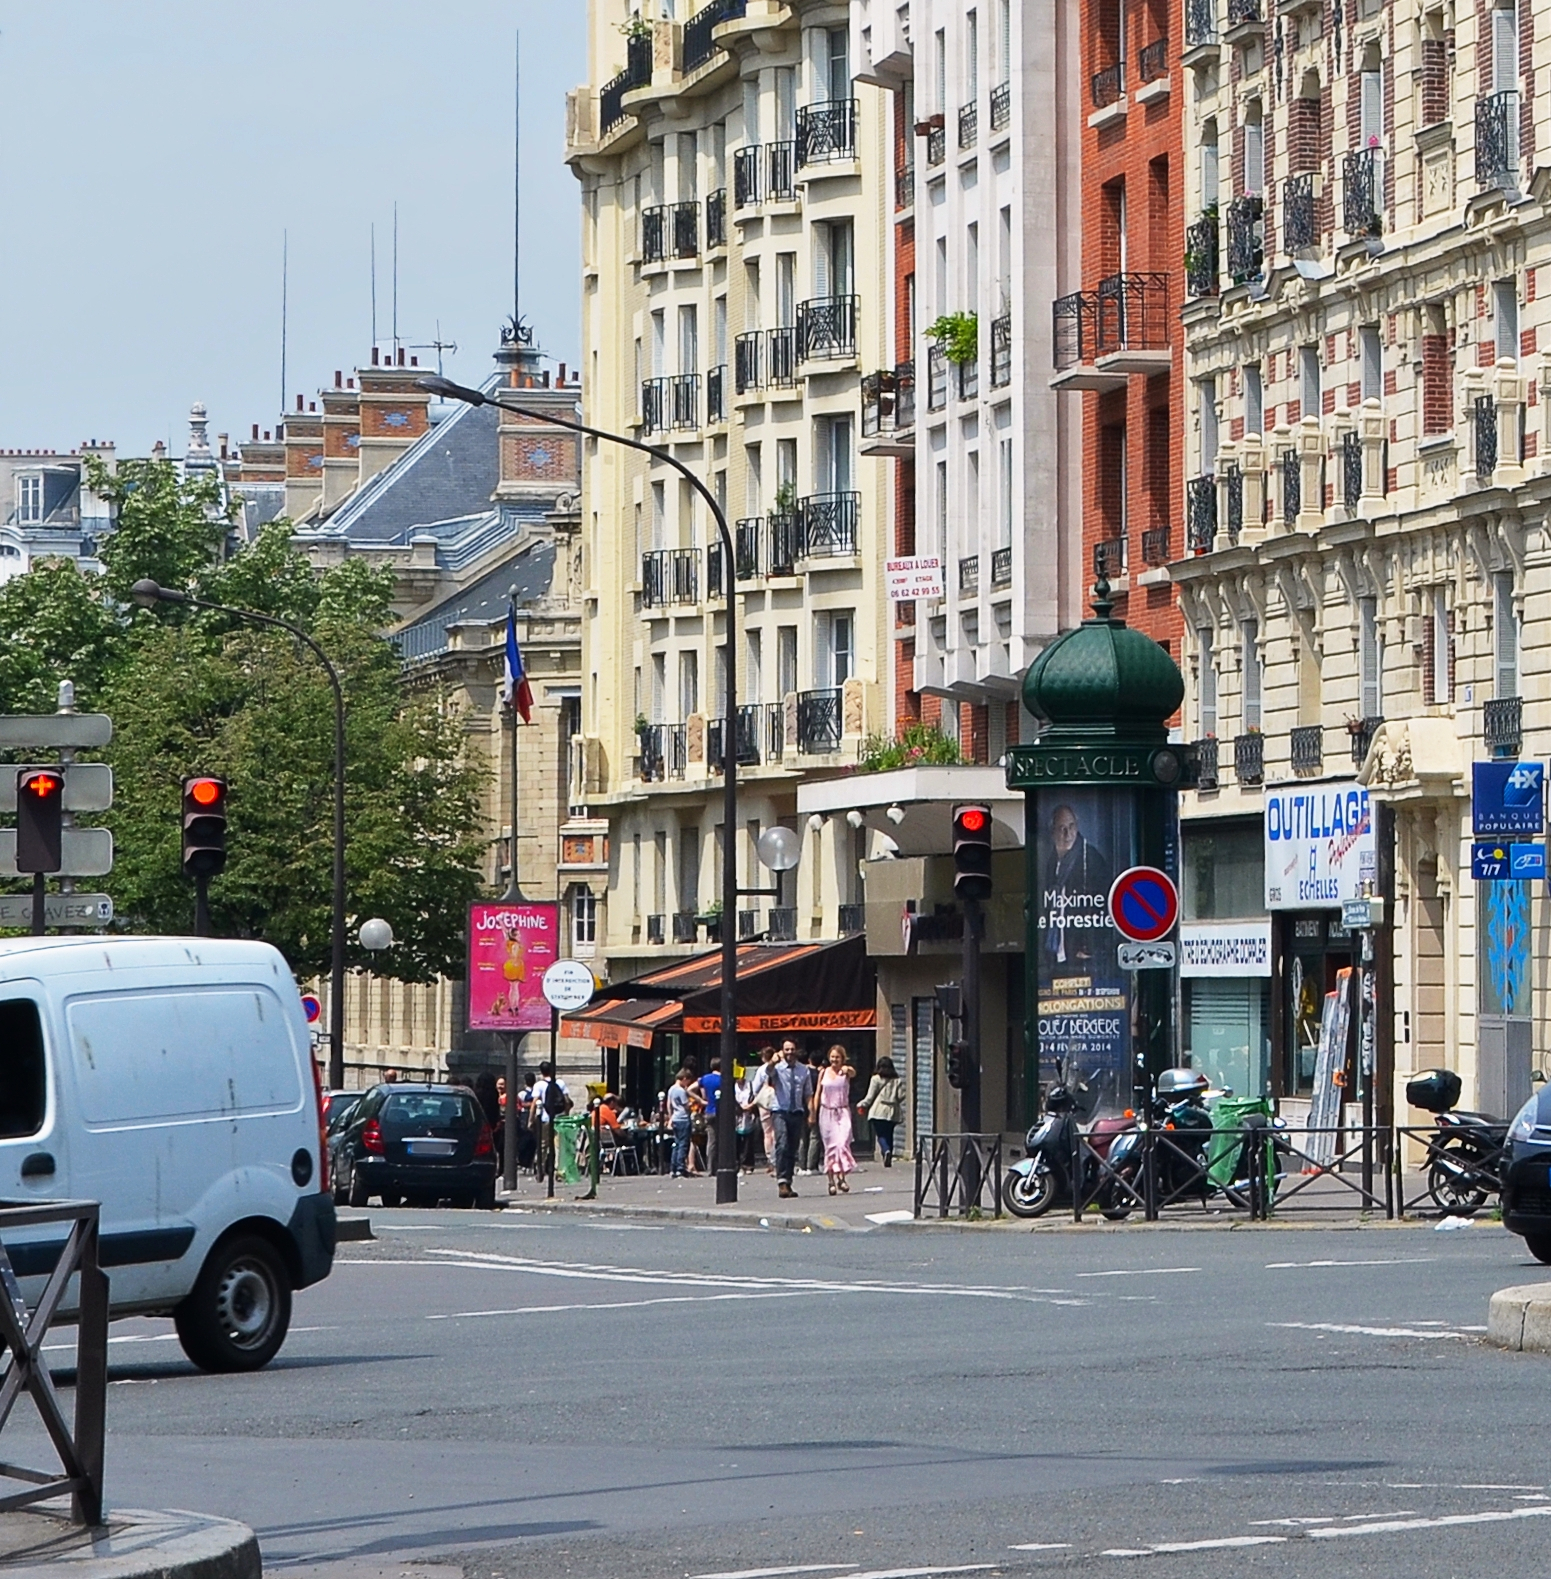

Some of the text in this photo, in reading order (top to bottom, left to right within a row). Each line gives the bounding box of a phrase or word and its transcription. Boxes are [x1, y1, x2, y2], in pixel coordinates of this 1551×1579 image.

[1016, 755, 1140, 777] SPECTACLE
[1268, 790, 1371, 841] OUTILLAGE
[1478, 812, 1540, 821] BANQUE
[1478, 822, 1540, 831] POPULAIRE
[1481, 863, 1501, 876] 7/7
[1299, 878, 1339, 900] ECHELLES
[1043, 889, 1105, 908] Maxime
[1037, 910, 1114, 929] e Forestie
[1038, 997, 1125, 1012] OLONGATIONS!
[700, 1014, 860, 1030] CAE RESTAURANT
[1090, 1042, 1112, 1052] 2014
